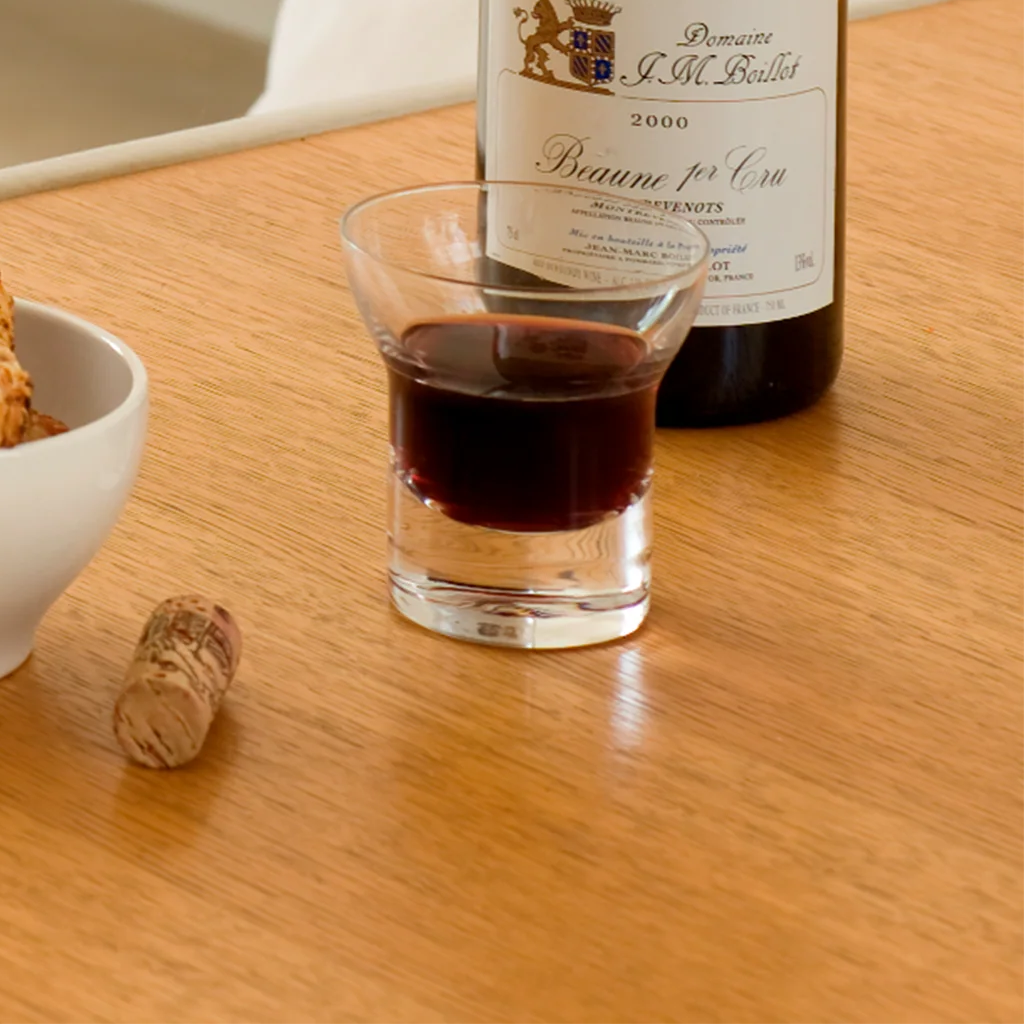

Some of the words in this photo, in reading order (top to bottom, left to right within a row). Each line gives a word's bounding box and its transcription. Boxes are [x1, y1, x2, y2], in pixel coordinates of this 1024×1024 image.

[676, 22, 773, 48] Domaine
[713, 51, 803, 86] Boillot
[630, 113, 688, 130] 2000
[535, 133, 669, 192] Beaune
[725, 144, 788, 195] Cru
[584, 243, 658, 259] JEAN-MARC
